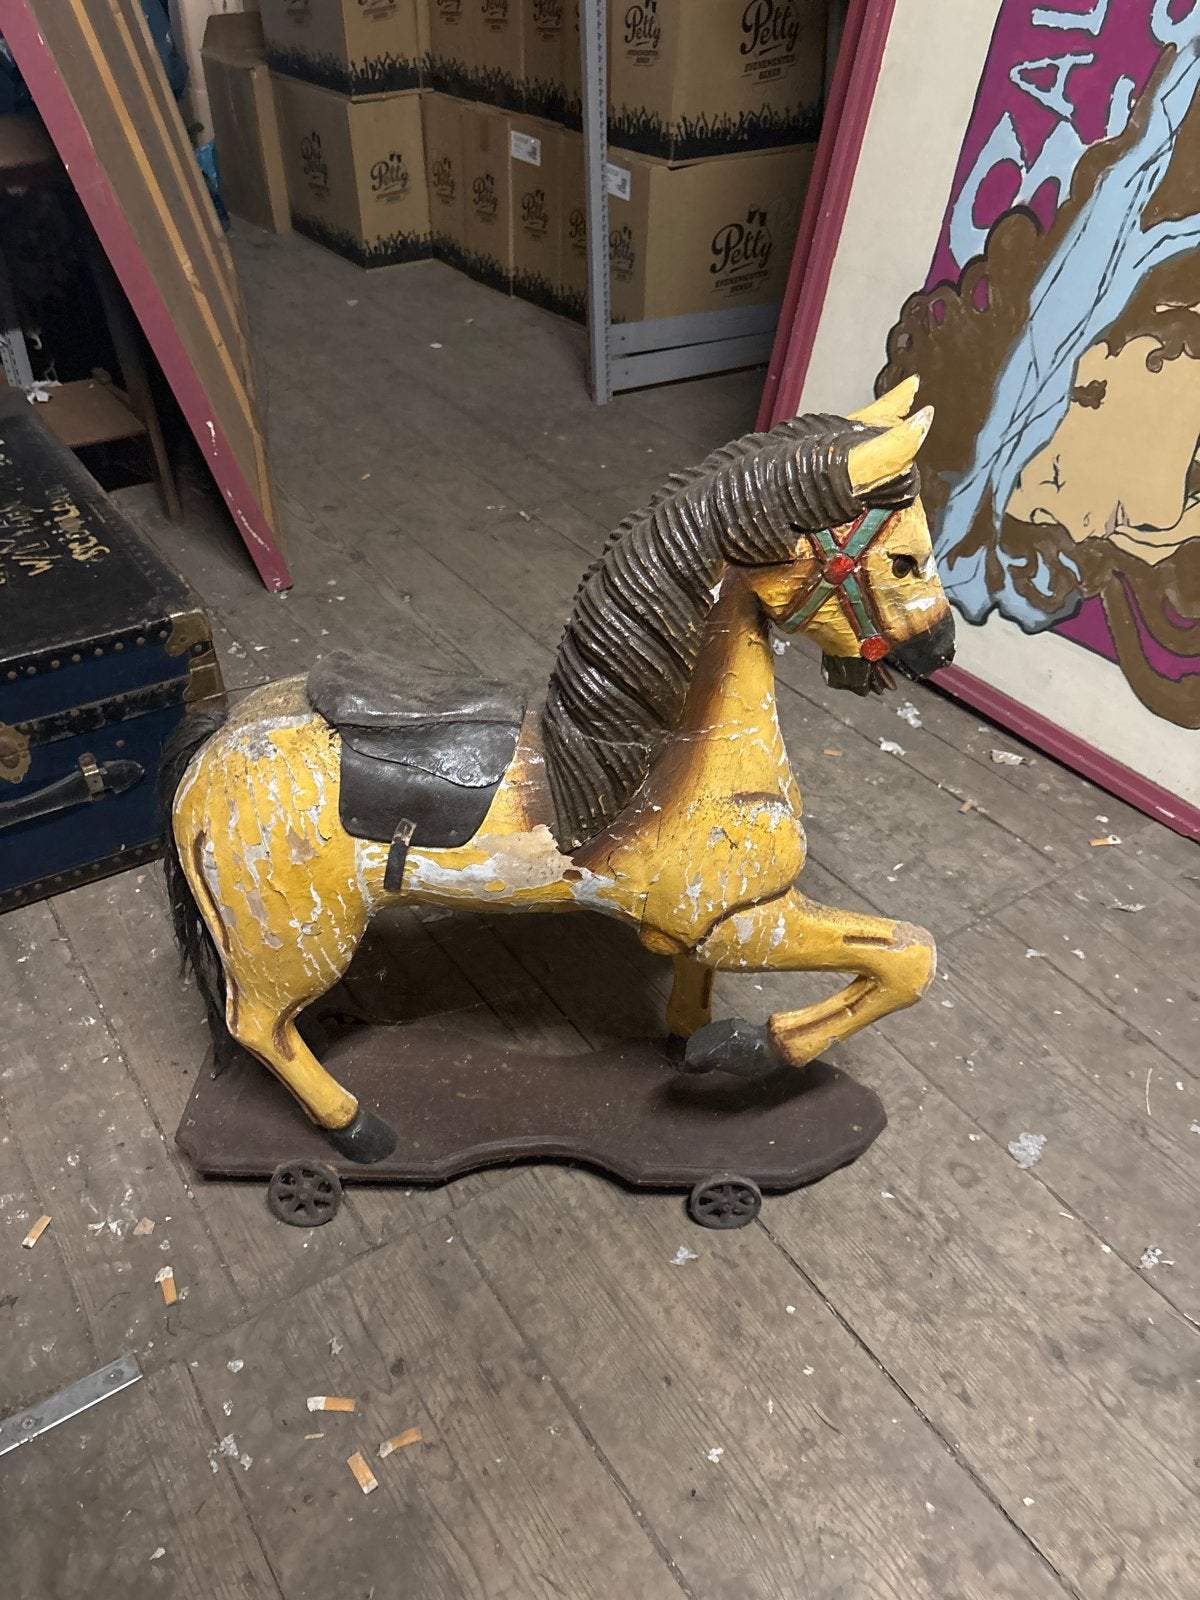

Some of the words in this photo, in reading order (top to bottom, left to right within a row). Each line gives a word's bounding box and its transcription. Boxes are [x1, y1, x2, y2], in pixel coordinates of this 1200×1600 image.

[624, 5, 661, 49] Petty
[740, 0, 800, 55] Petty
[710, 223, 772, 274] Petty
